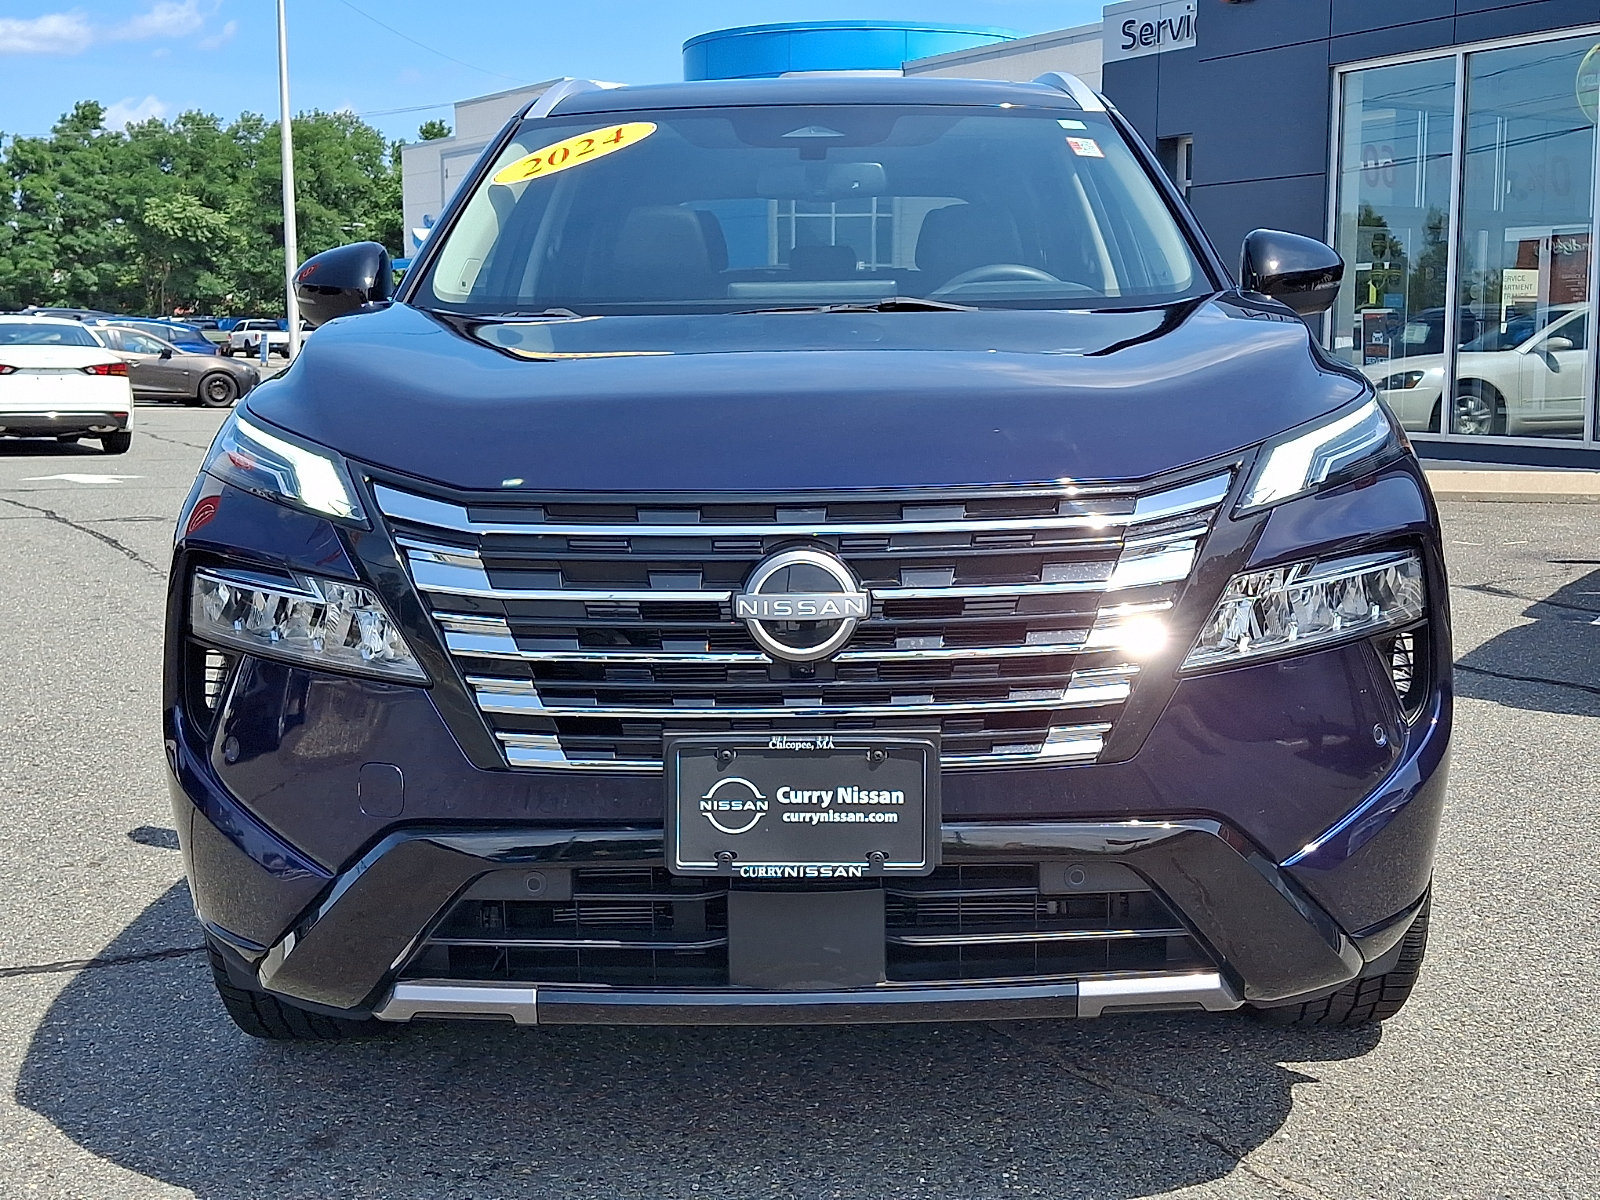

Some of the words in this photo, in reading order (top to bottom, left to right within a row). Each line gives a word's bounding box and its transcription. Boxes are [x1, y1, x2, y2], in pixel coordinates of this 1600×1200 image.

[1121, 4, 1197, 50] Servi
[523, 128, 624, 178] 2024
[739, 598, 864, 616] NISSAN
[816, 739, 835, 749] MA
[700, 800, 769, 811] NISSAN
[776, 786, 834, 808] Curry
[837, 786, 905, 804] Nissan
[782, 809, 898, 825] currynissan.com
